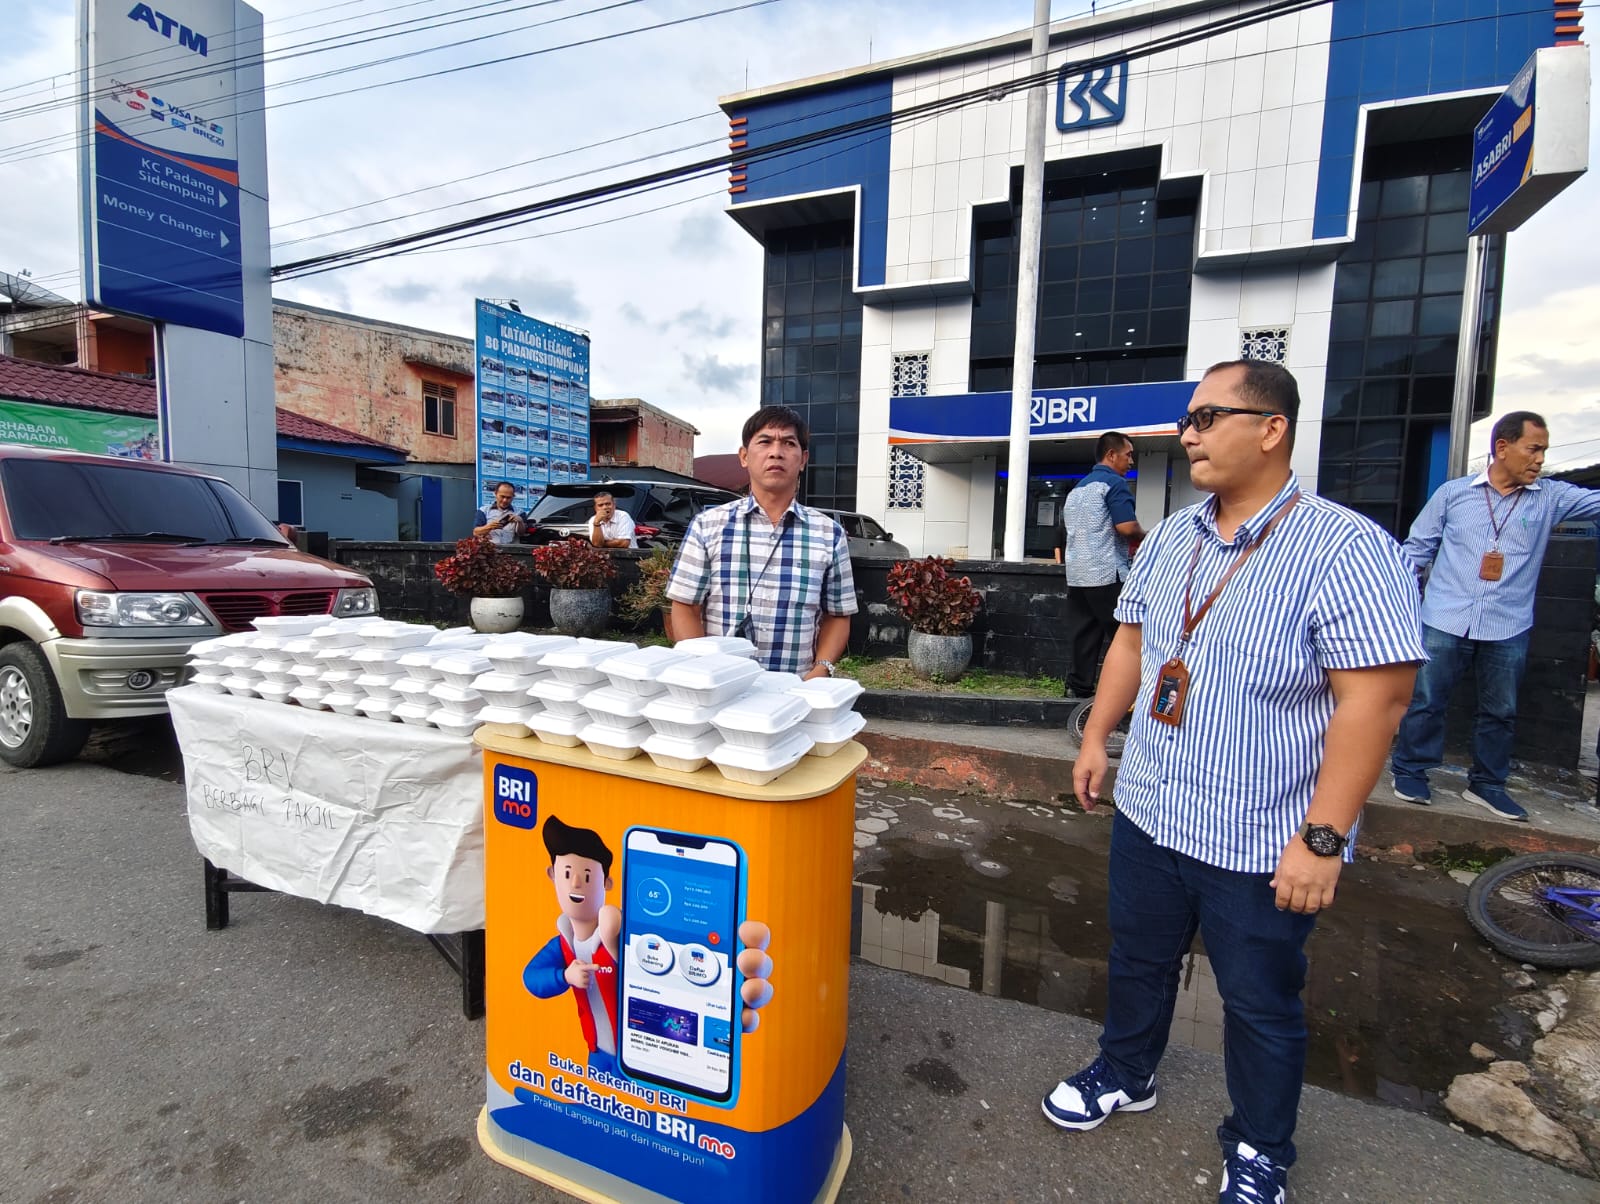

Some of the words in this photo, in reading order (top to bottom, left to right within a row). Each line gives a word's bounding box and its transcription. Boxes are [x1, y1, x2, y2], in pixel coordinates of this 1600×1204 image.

[127, 2, 208, 57] ATM
[166, 103, 192, 121] VISA
[192, 126, 225, 147] BRIZZI
[1475, 129, 1512, 182] ASABRI
[138, 169, 215, 206] Sidempuan
[141, 157, 161, 174] KC
[165, 166, 215, 196] Padang
[103, 194, 154, 221] Money
[159, 213, 216, 240] Changer
[500, 325, 541, 349] KATALOG
[543, 339, 573, 359] LELANG
[1048, 396, 1097, 424] BRI
[0, 420, 56, 435] RHABAN
[0, 430, 69, 445] RAMADAN
[203, 784, 265, 816] BERBAGI
[498, 775, 531, 802] BRI
[502, 799, 532, 818] mo
[549, 1052, 583, 1076] Buka
[588, 1067, 655, 1104] Rekening
[659, 1092, 687, 1113] BRI
[509, 1061, 545, 1088] dan
[551, 1076, 650, 1128] daftarkan
[656, 1112, 695, 1144] BRI
[698, 1134, 736, 1160] mo
[533, 1094, 563, 1114] Praktis
[565, 1105, 610, 1134] Langsung
[611, 1125, 629, 1138] jadi
[631, 1132, 649, 1147] dari
[652, 1141, 680, 1157] mana
[682, 1151, 705, 1168] pun!
